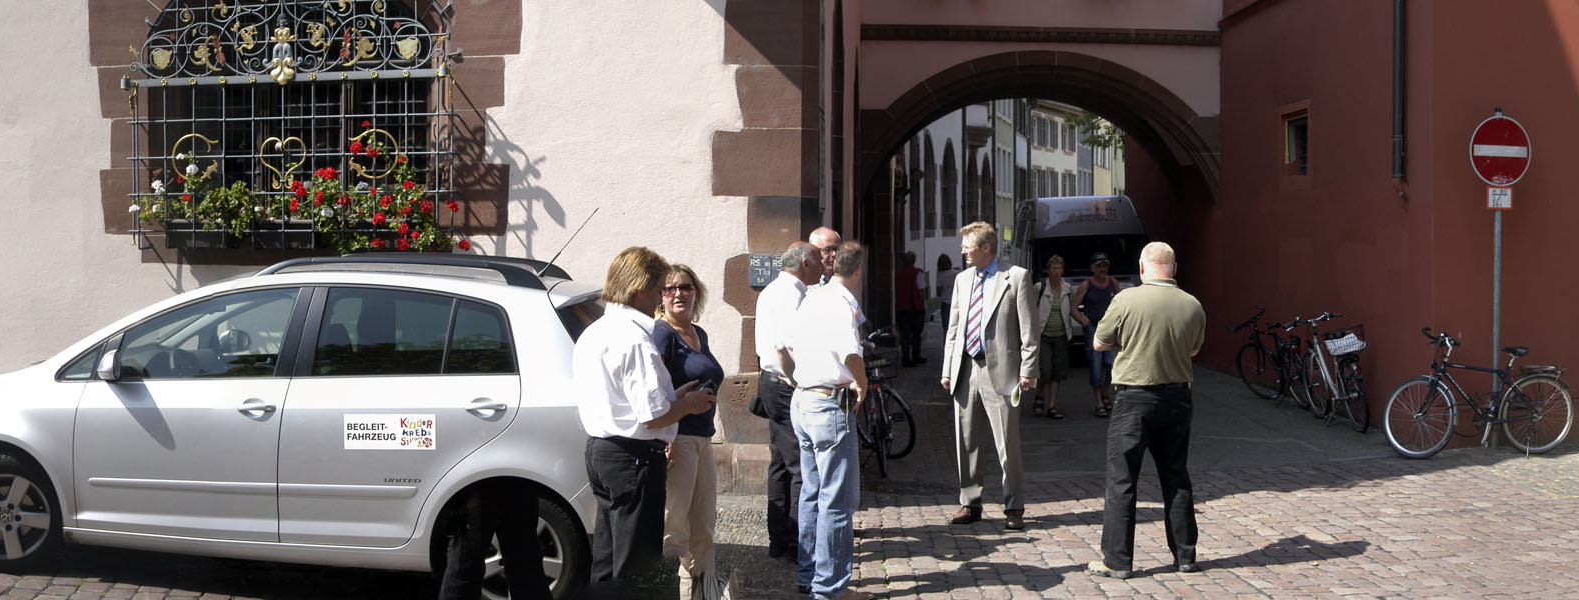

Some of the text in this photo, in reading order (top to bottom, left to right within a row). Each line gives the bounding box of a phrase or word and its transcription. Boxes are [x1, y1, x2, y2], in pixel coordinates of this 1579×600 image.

[750, 258, 761, 267] RS
[346, 423, 388, 431] BEGLEIT-
[346, 433, 397, 441] FAHRZEUG
